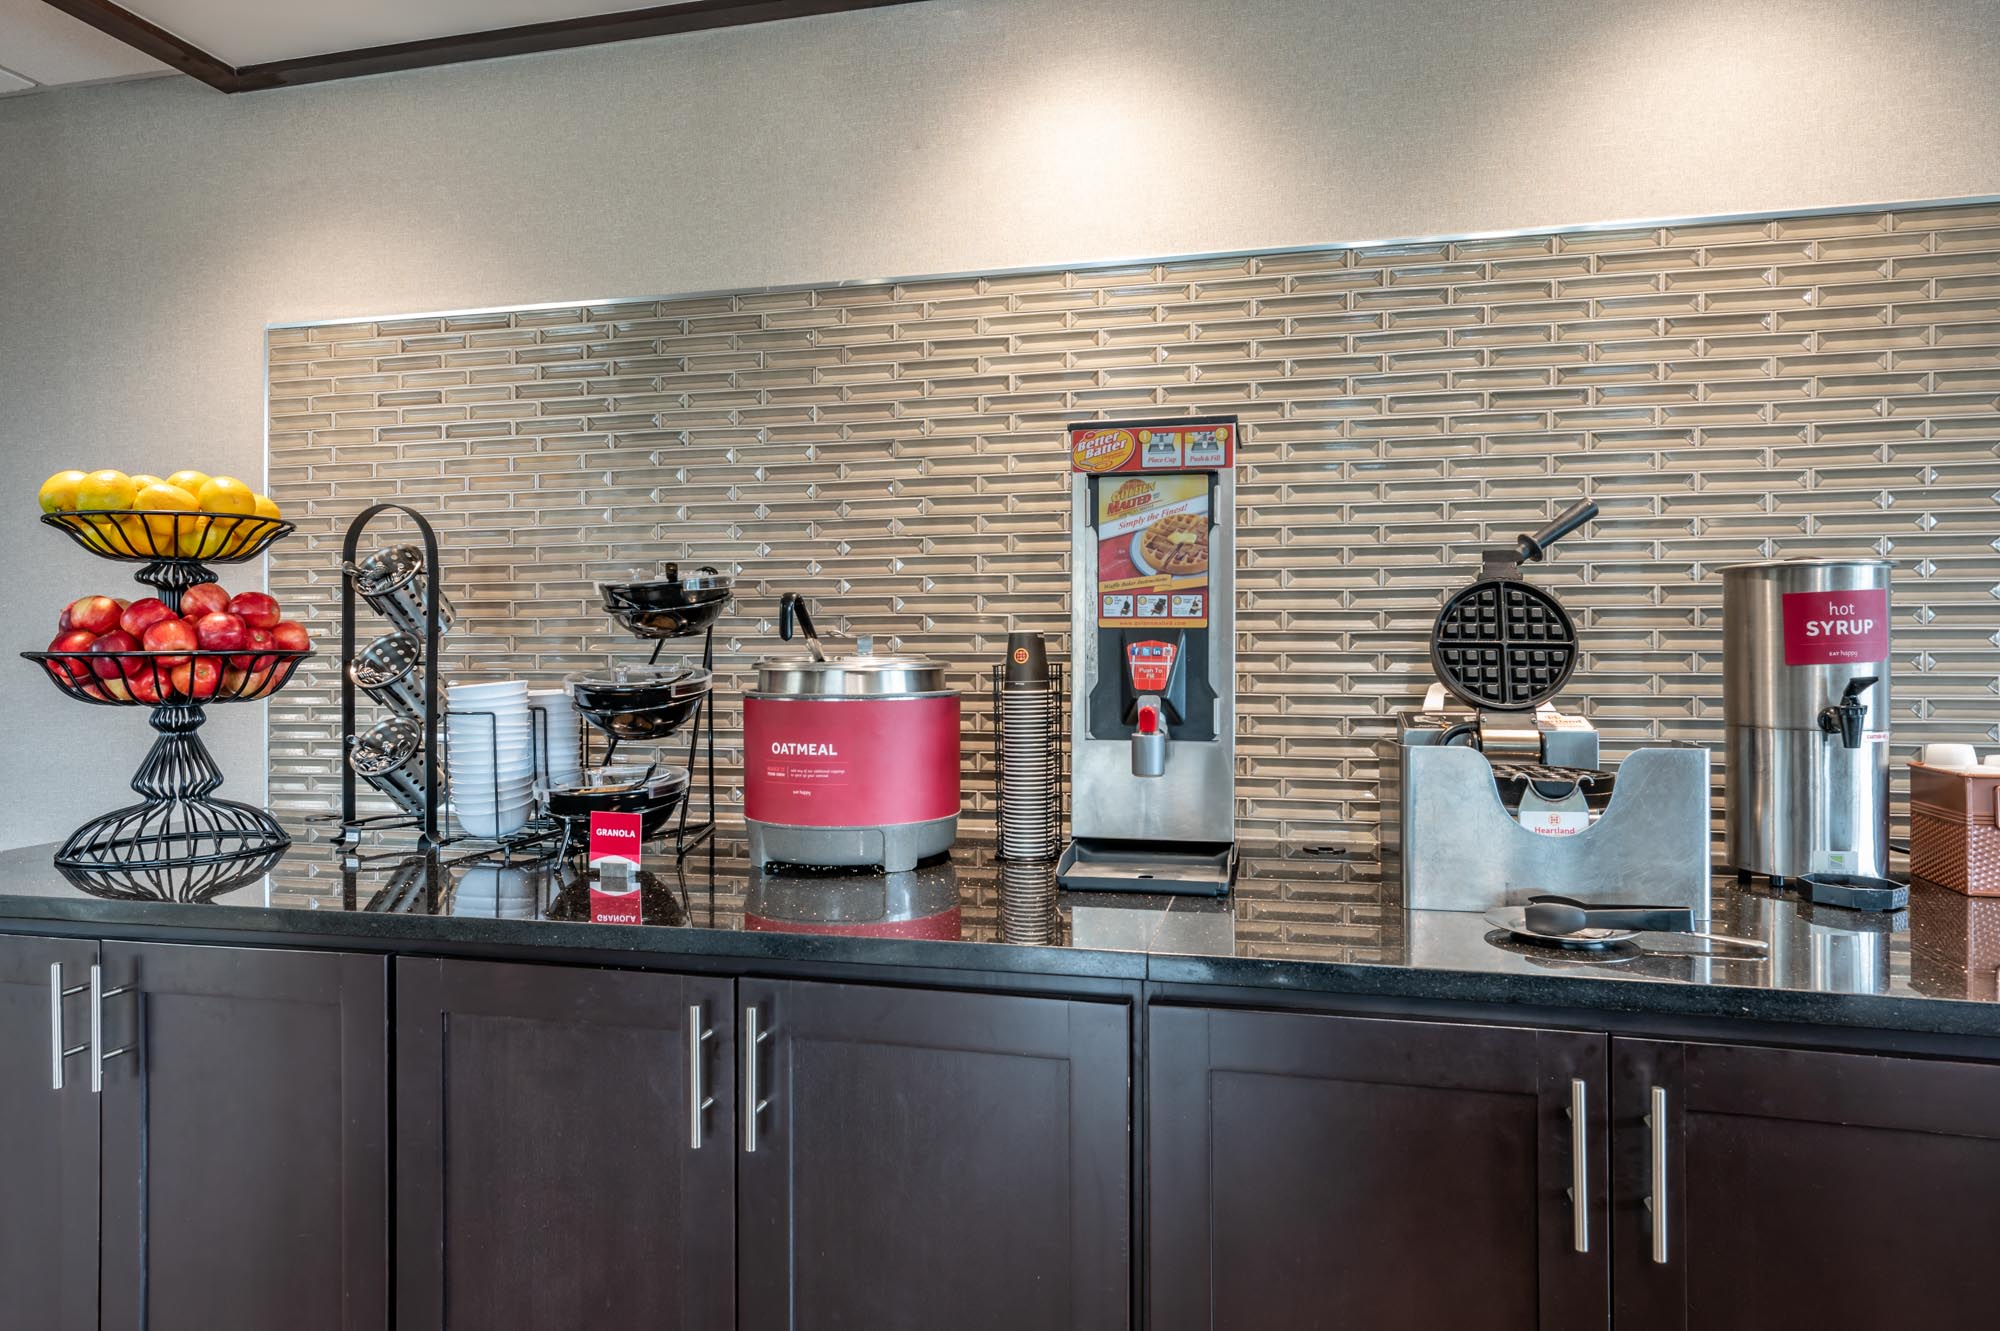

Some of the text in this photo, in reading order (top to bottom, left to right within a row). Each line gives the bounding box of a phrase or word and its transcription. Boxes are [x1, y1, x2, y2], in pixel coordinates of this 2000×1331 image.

[1078, 431, 1119, 452] Better
[1085, 439, 1127, 459] Batter
[1107, 493, 1152, 515] MALTED
[1118, 516, 1145, 530] Simply
[1147, 512, 1160, 522] the
[1161, 503, 1188, 517] Finest!
[1829, 601, 1855, 616] hot
[1806, 619, 1874, 637] SYRUP
[1841, 649, 1858, 657] happy
[772, 742, 838, 755] OATMEAL
[596, 828, 636, 838] GRANOLA
[1535, 826, 1575, 835] Heartland
